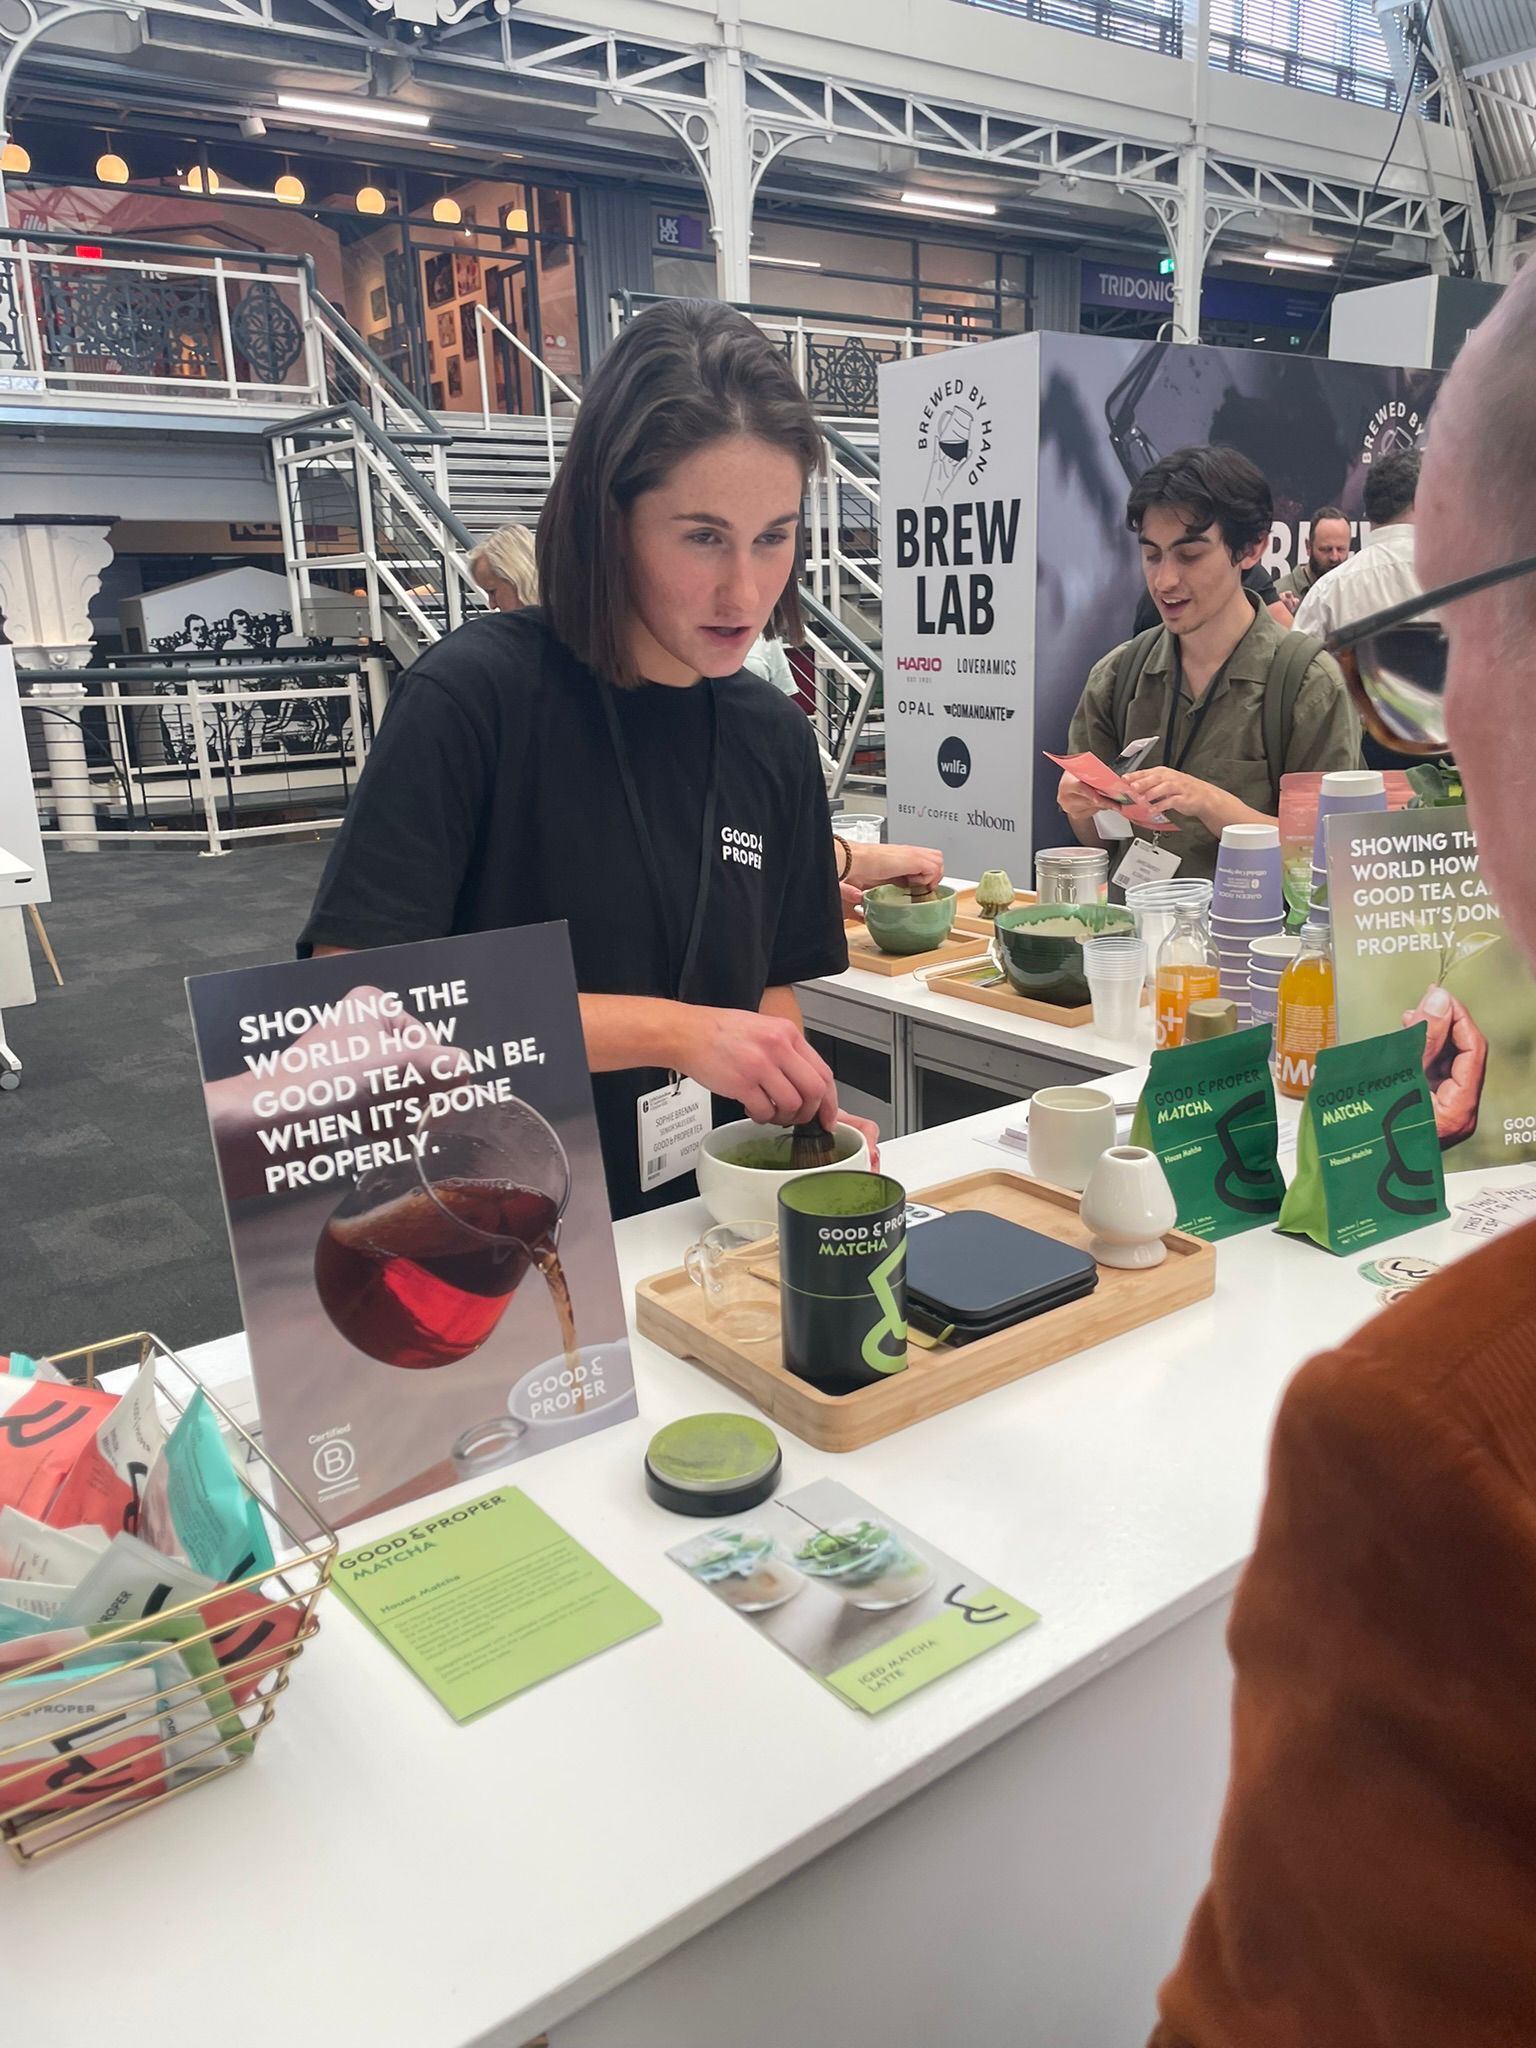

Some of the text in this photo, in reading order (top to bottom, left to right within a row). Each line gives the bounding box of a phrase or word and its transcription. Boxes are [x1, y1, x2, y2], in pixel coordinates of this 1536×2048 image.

[917, 379, 992, 486] BREWED BY HAND
[1361, 401, 1425, 464] BREWED BY
[896, 498, 1021, 568] BREW
[916, 573, 995, 635] LAB
[896, 656, 942, 672] HARIO
[956, 657, 1016, 676] LOVERAMICS
[897, 700, 935, 716] OPAL
[951, 703, 1006, 722] COMANDANTE
[940, 759, 967, 775] wilfa
[898, 804, 959, 822] BEST COFFEE
[966, 809, 1015, 832] xbloom
[721, 826, 758, 850] GOOD
[1350, 831, 1478, 858] SHOWING TH
[1352, 854, 1480, 882] WORLD HOW
[1353, 879, 1492, 907] GOOD TEA CA
[1355, 903, 1503, 931] WHEN IT'S DON
[1356, 931, 1461, 957] PROPERLY.
[238, 979, 469, 1045] SHOWING THE
[243, 1016, 457, 1080] WORLD HOW
[252, 1036, 546, 1119] GOOD TEA CAN BE,
[1154, 1085, 1194, 1108] GOOD
[1208, 1068, 1262, 1092] PROPER
[1316, 1087, 1355, 1109] GOOD
[1367, 1067, 1417, 1091] PROPER
[256, 1077, 513, 1156] WHEN IT'S DONE
[655, 1103, 699, 1128] SOPHIE BRENNAN
[1156, 1099, 1213, 1125] MATCHA
[1321, 1099, 1373, 1127] MATCHA
[1504, 1116, 1536, 1131] GOO
[653, 1139, 669, 1152] GOOD
[675, 1128, 692, 1143] PROPER
[692, 1123, 704, 1135] TEA
[264, 1130, 440, 1194] PROPERLY.
[1468, 1198, 1498, 1209] THIS
[1495, 1188, 1530, 1197] THIS
[818, 1227, 868, 1241] GOOD
[1463, 1216, 1482, 1230] THIS
[818, 1237, 889, 1257] MATCHA
[527, 1356, 604, 1398] GOOD &
[529, 1380, 607, 1419] PROPER
[308, 1421, 351, 1445] Certified
[322, 1447, 346, 1475] B
[338, 1494, 506, 1571] GOOD & PROPER
[352, 1540, 437, 1582] MATCHA
[379, 1575, 461, 1614] House Matcha
[857, 1640, 936, 1685] ICED MATCHA
[867, 1670, 905, 1692] LATTE
